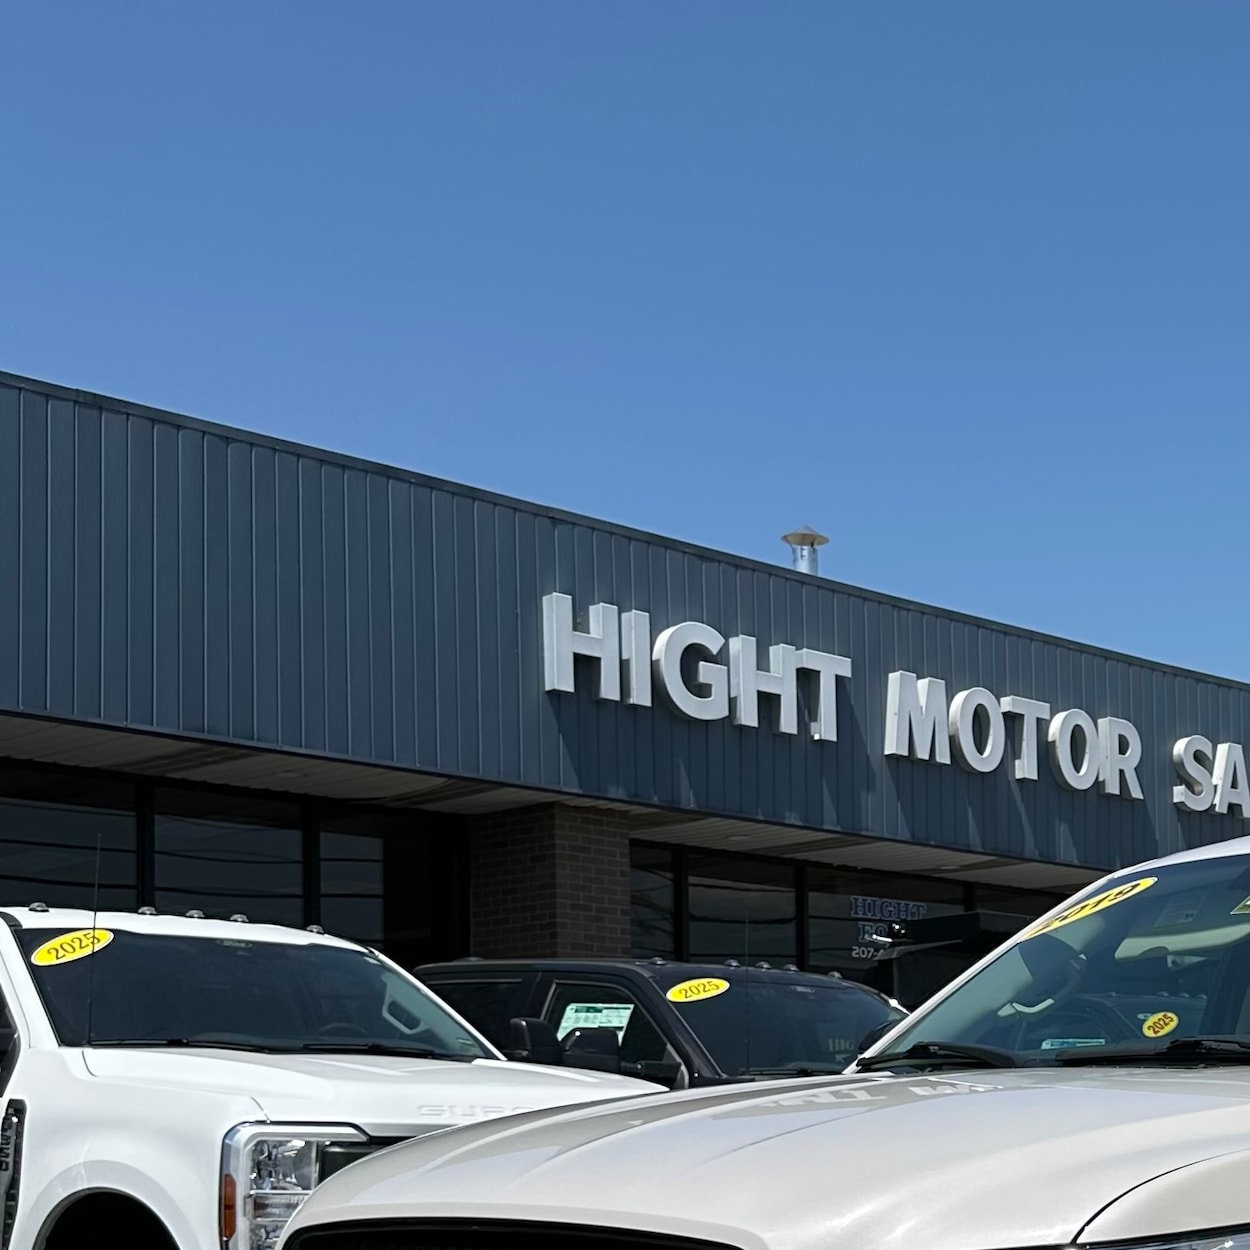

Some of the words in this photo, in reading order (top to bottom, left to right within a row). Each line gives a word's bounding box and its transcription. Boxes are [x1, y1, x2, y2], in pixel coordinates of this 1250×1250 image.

[542, 592, 852, 743] HIGHT
[884, 670, 1145, 801] MOTOR
[850, 896, 928, 921] HIGHT
[1028, 882, 1142, 937] 2019
[47, 931, 101, 961] 2025
[678, 980, 720, 999] 2025
[1146, 1012, 1176, 1035] 2025
